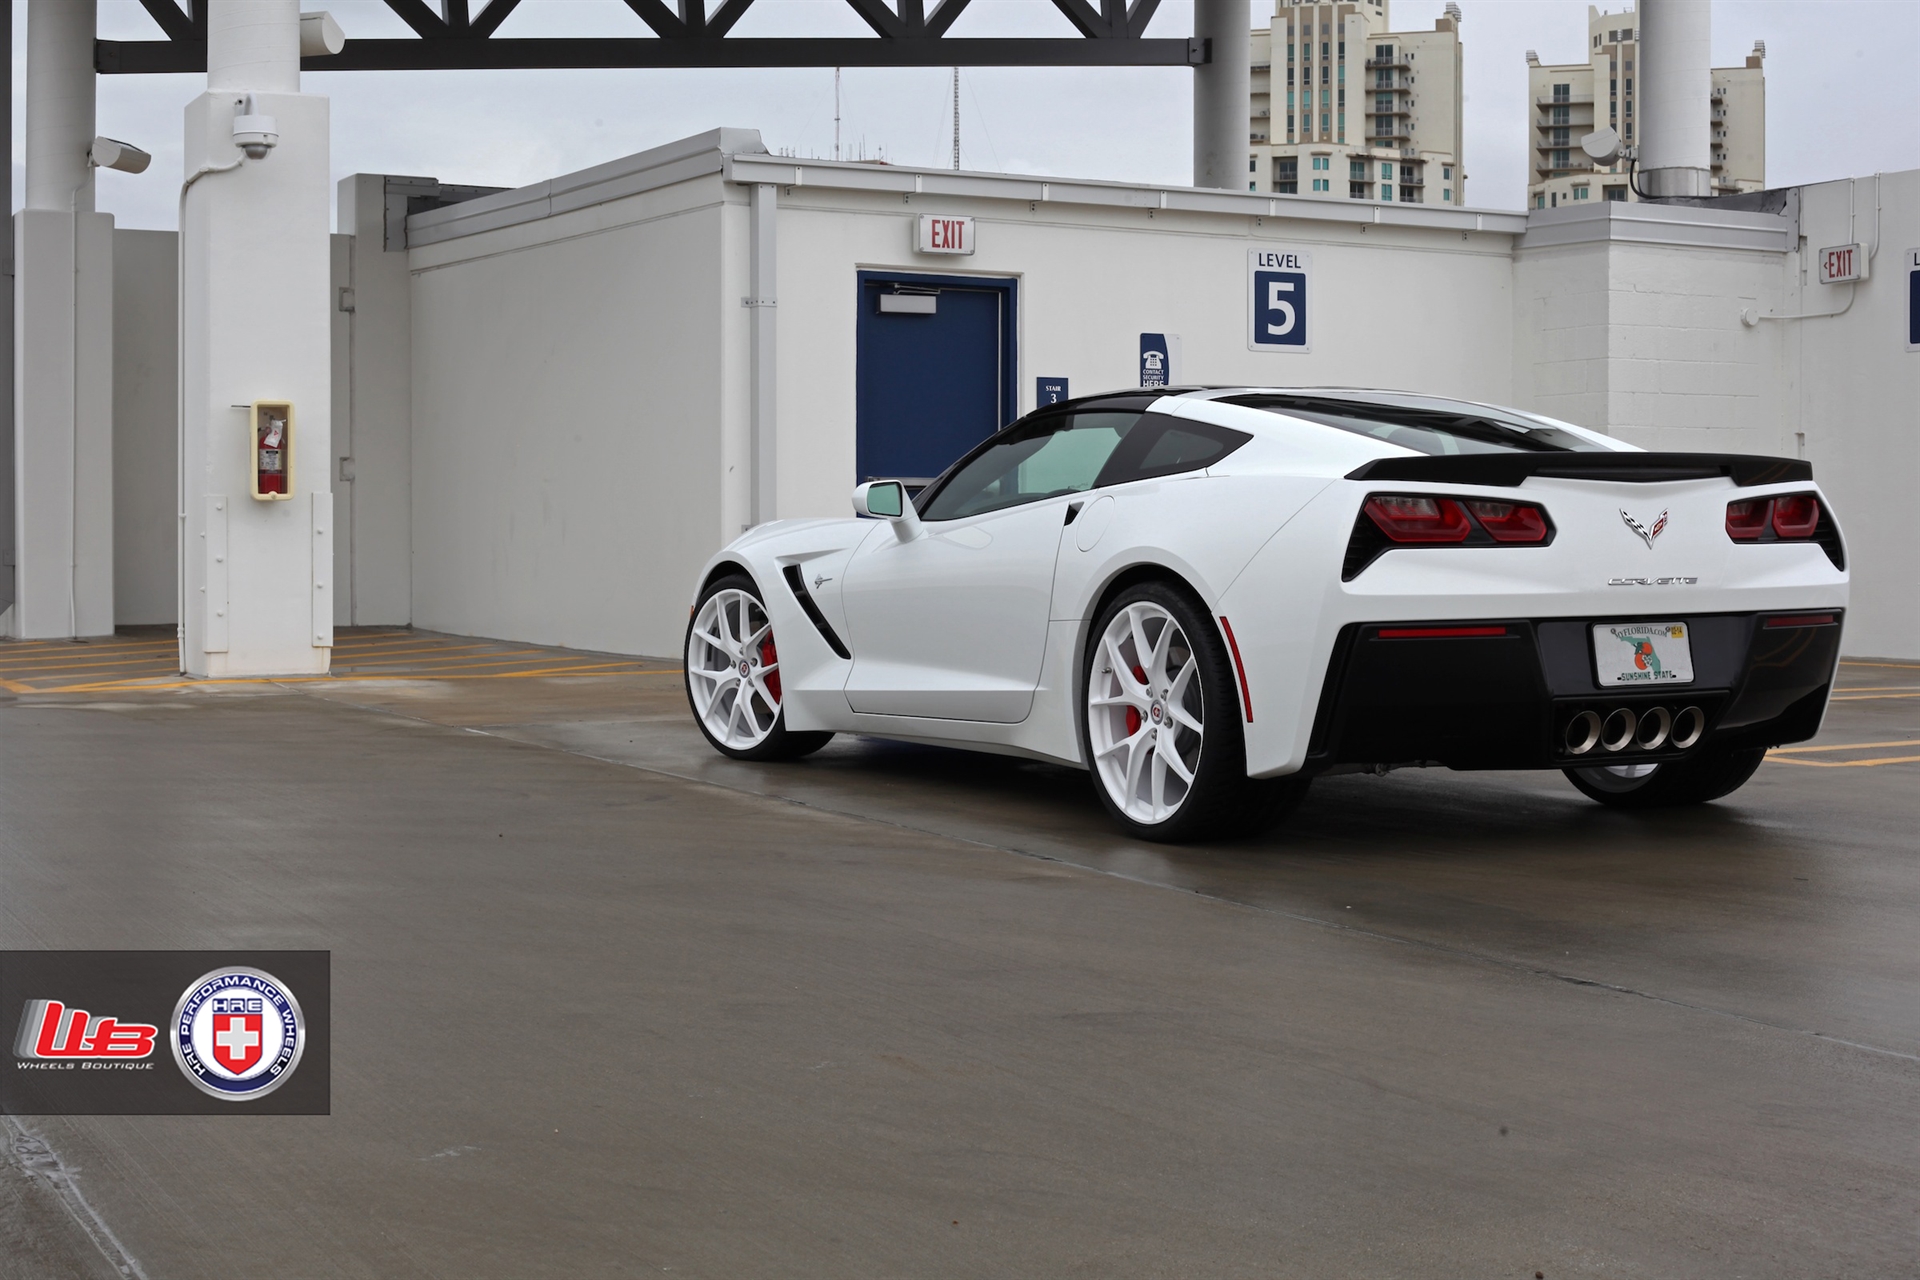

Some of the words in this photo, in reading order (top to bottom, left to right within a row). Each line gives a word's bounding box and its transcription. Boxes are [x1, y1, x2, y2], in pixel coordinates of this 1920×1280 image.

[932, 219, 965, 249] EXIT
[1258, 253, 1301, 269] LEVEL
[1828, 249, 1853, 278] EXIT
[1267, 281, 1296, 336] 5
[1050, 393, 1057, 403] 3
[1608, 577, 1698, 586] CORVETTE
[1621, 672, 1651, 681] SUNSHINE
[1653, 670, 1673, 680] STATE
